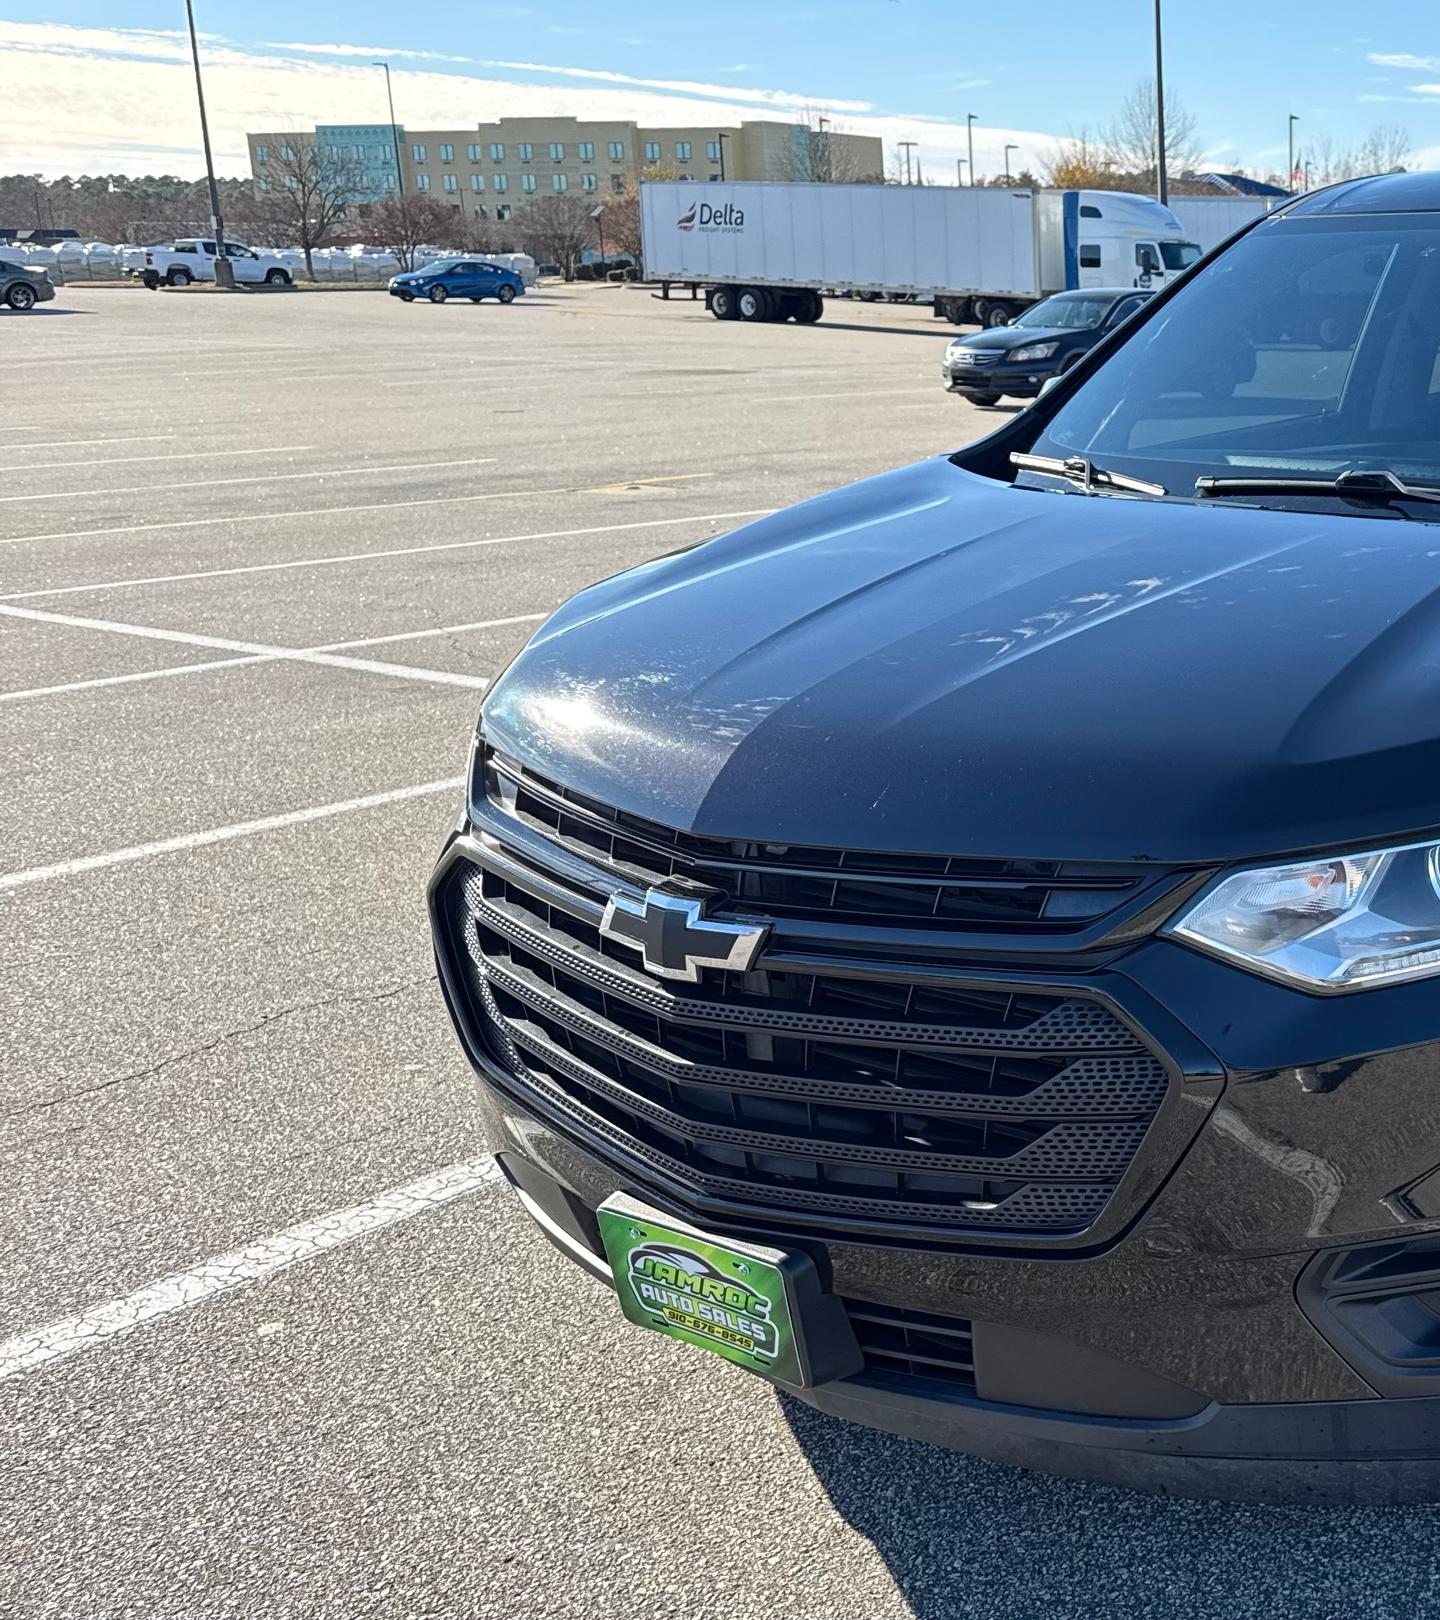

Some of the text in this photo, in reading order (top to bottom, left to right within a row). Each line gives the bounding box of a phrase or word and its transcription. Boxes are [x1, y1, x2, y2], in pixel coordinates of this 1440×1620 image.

[699, 203, 744, 226] Delta
[633, 1258, 769, 1319] JAMROC
[640, 1282, 767, 1342] AUTO SALES
[668, 1310, 752, 1349] 910-676-8545
